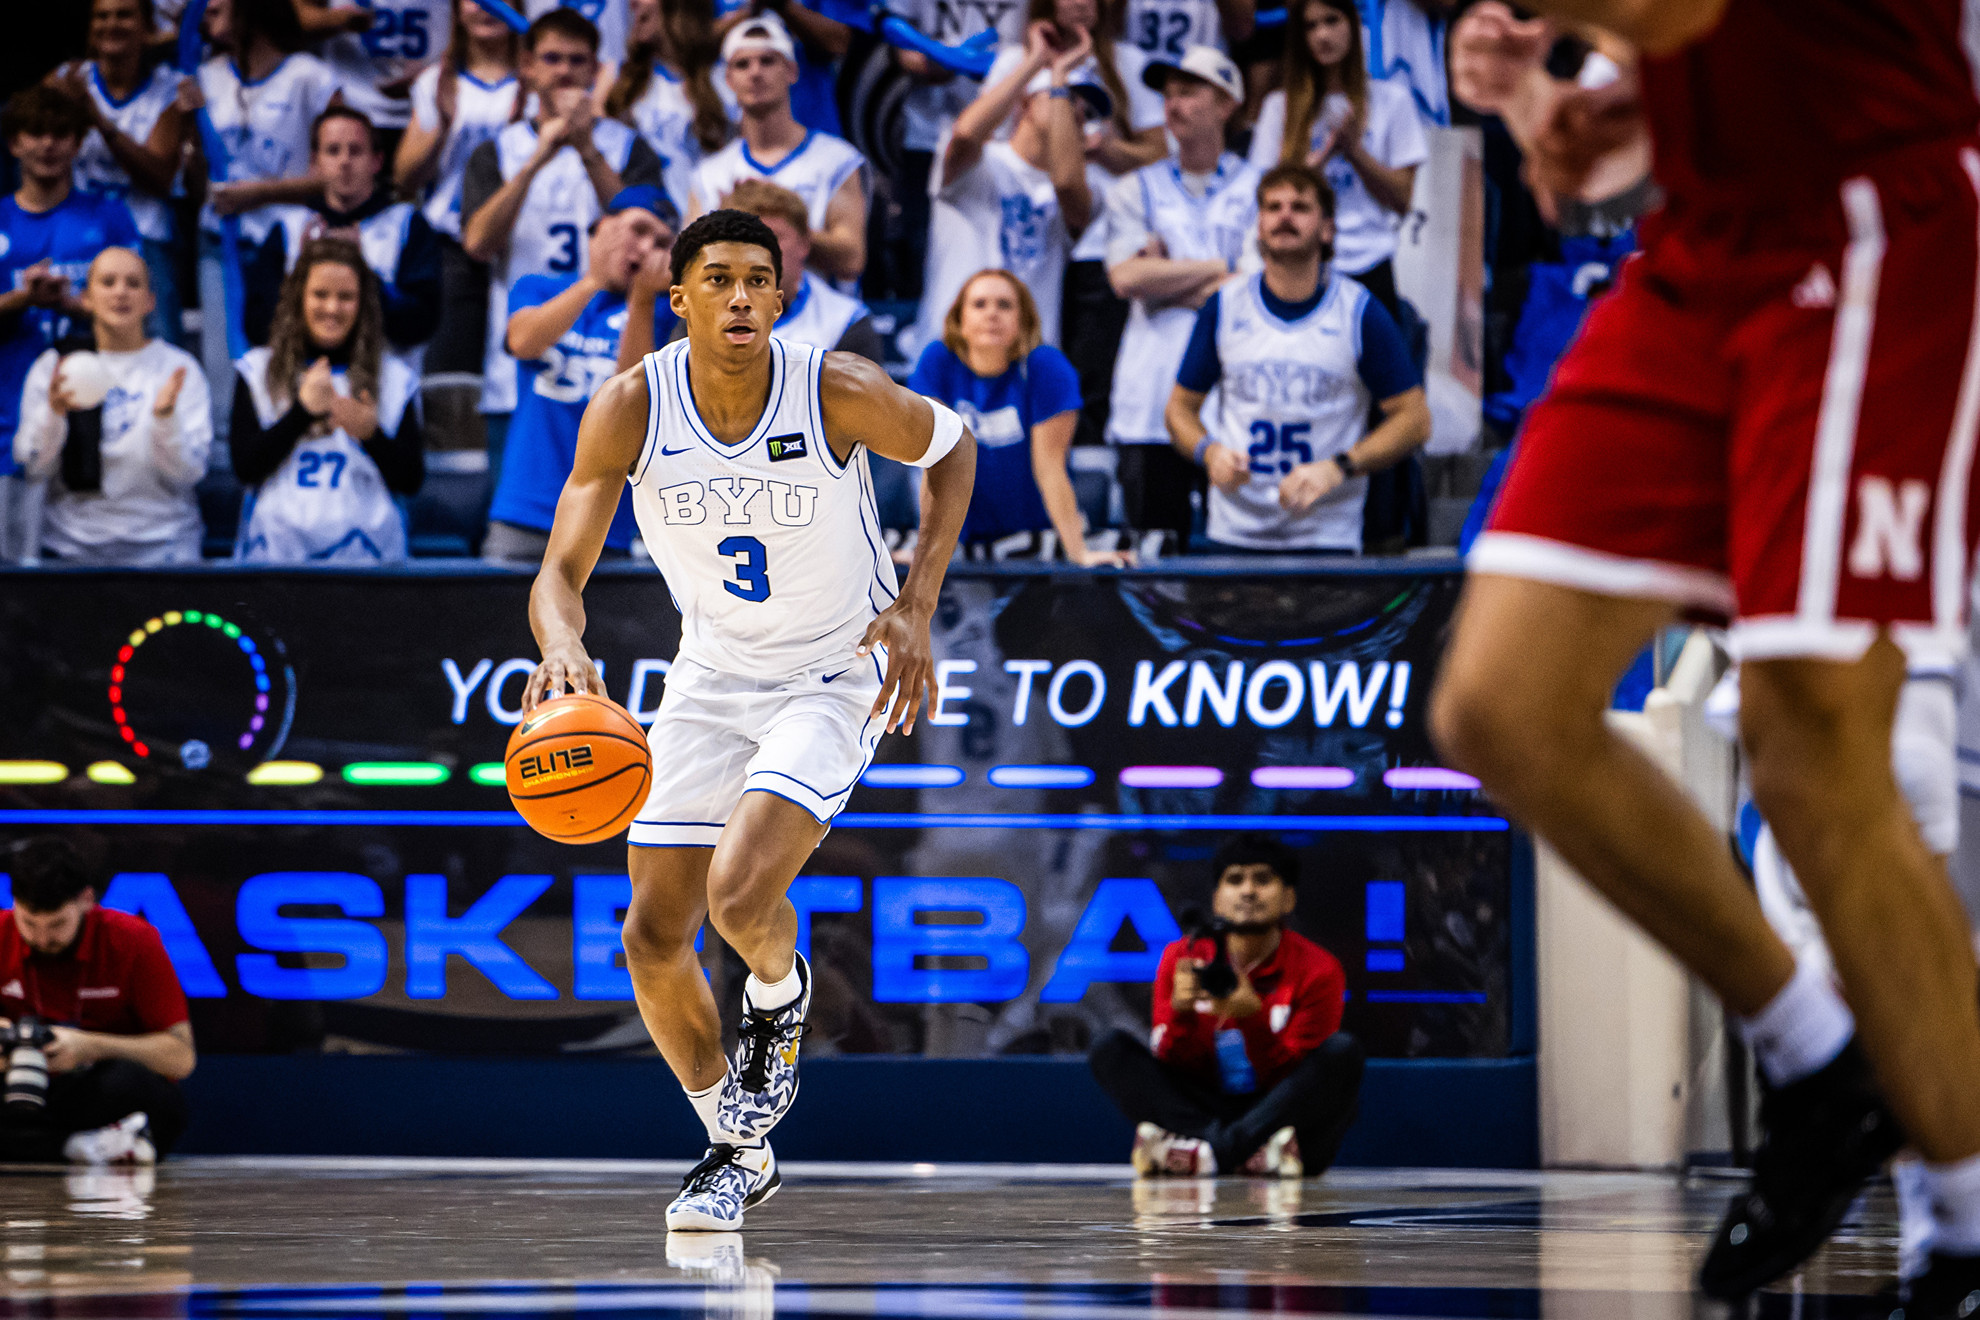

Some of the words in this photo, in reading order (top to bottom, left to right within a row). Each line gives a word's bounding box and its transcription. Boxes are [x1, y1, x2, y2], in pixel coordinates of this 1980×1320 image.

[360, 9, 428, 58] 25
[1138, 10, 1191, 54] 32
[297, 451, 347, 489] 27
[1248, 420, 1313, 474] 25
[659, 477, 818, 527] BYU
[1848, 475, 1931, 580] N
[717, 536, 771, 603] 3
[441, 658, 606, 726] YO
[1003, 659, 1108, 728] TO
[1127, 659, 1412, 728] KNOW!
[519, 744, 594, 780] ELITE
